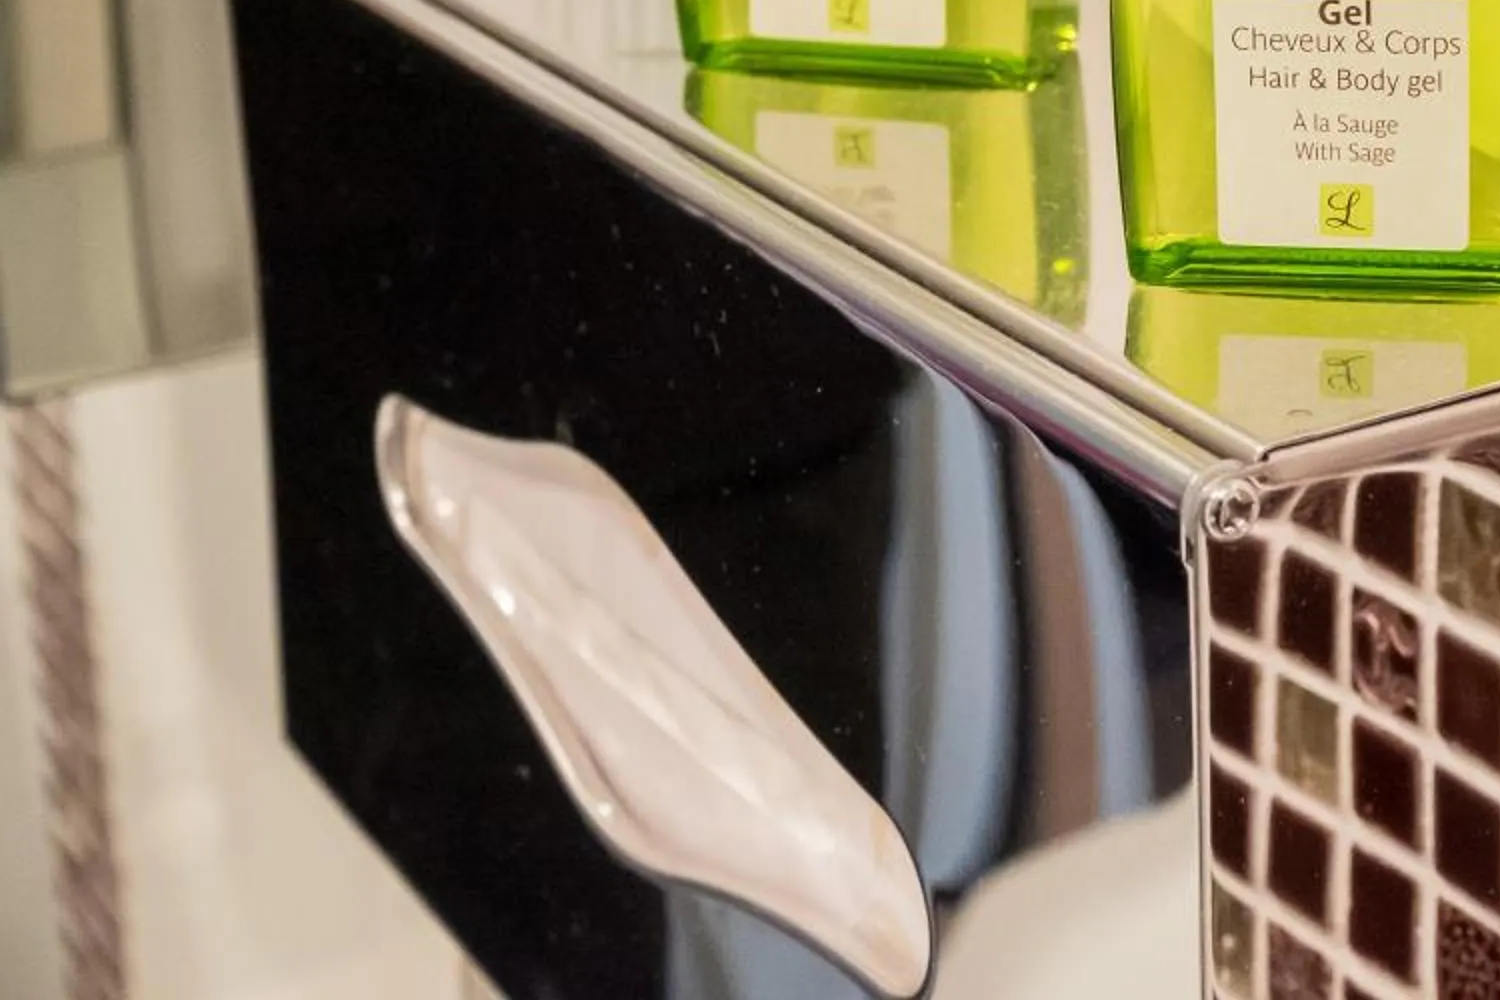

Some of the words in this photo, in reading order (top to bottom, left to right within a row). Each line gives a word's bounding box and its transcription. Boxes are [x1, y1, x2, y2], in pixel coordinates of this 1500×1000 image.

[1318, 0, 1373, 26] Gel
[1230, 26, 1346, 54] Cheveux
[1355, 29, 1375, 53] &
[1385, 31, 1462, 60] Corps
[1249, 65, 1300, 90] Hair
[1309, 68, 1327, 90] &
[1337, 69, 1399, 97] Body
[1407, 71, 1444, 97] gel
[1293, 109, 1307, 132] À
[1313, 114, 1330, 133] la
[1337, 114, 1399, 138] Sauge
[1295, 142, 1341, 161] With
[1349, 142, 1397, 167] Sage
